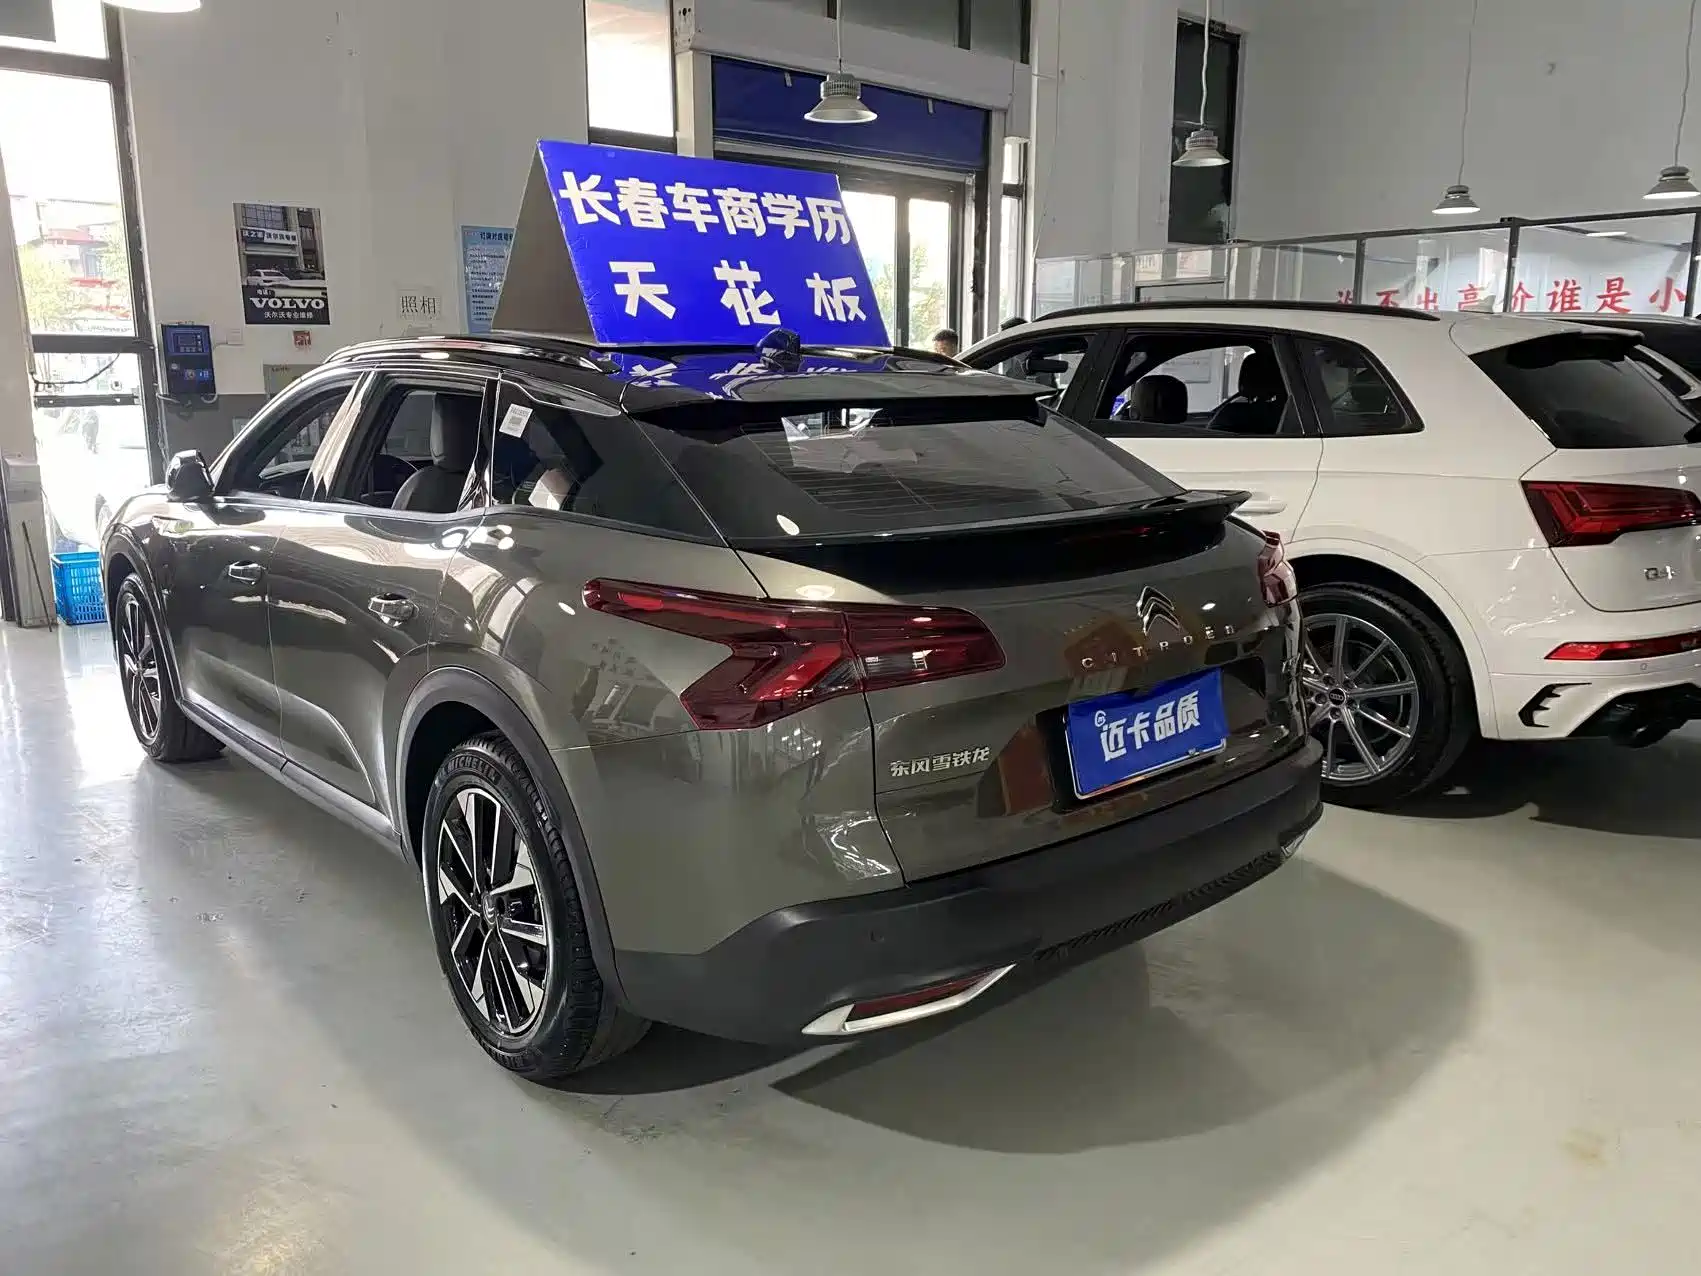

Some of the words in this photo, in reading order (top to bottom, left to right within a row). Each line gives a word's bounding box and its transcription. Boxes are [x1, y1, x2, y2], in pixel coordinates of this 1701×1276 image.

[559, 172, 851, 245] 长春车商学历
[249, 297, 325, 310] VOLVO
[401, 295, 436, 314] 照相
[609, 259, 866, 326] 天花板
[264, 311, 313, 319] 沃尔沃专业维修
[1100, 690, 1201, 762] 迈卡品质
[447, 755, 497, 782] MICHELIN
[890, 746, 990, 777] 东风雪铁龙
